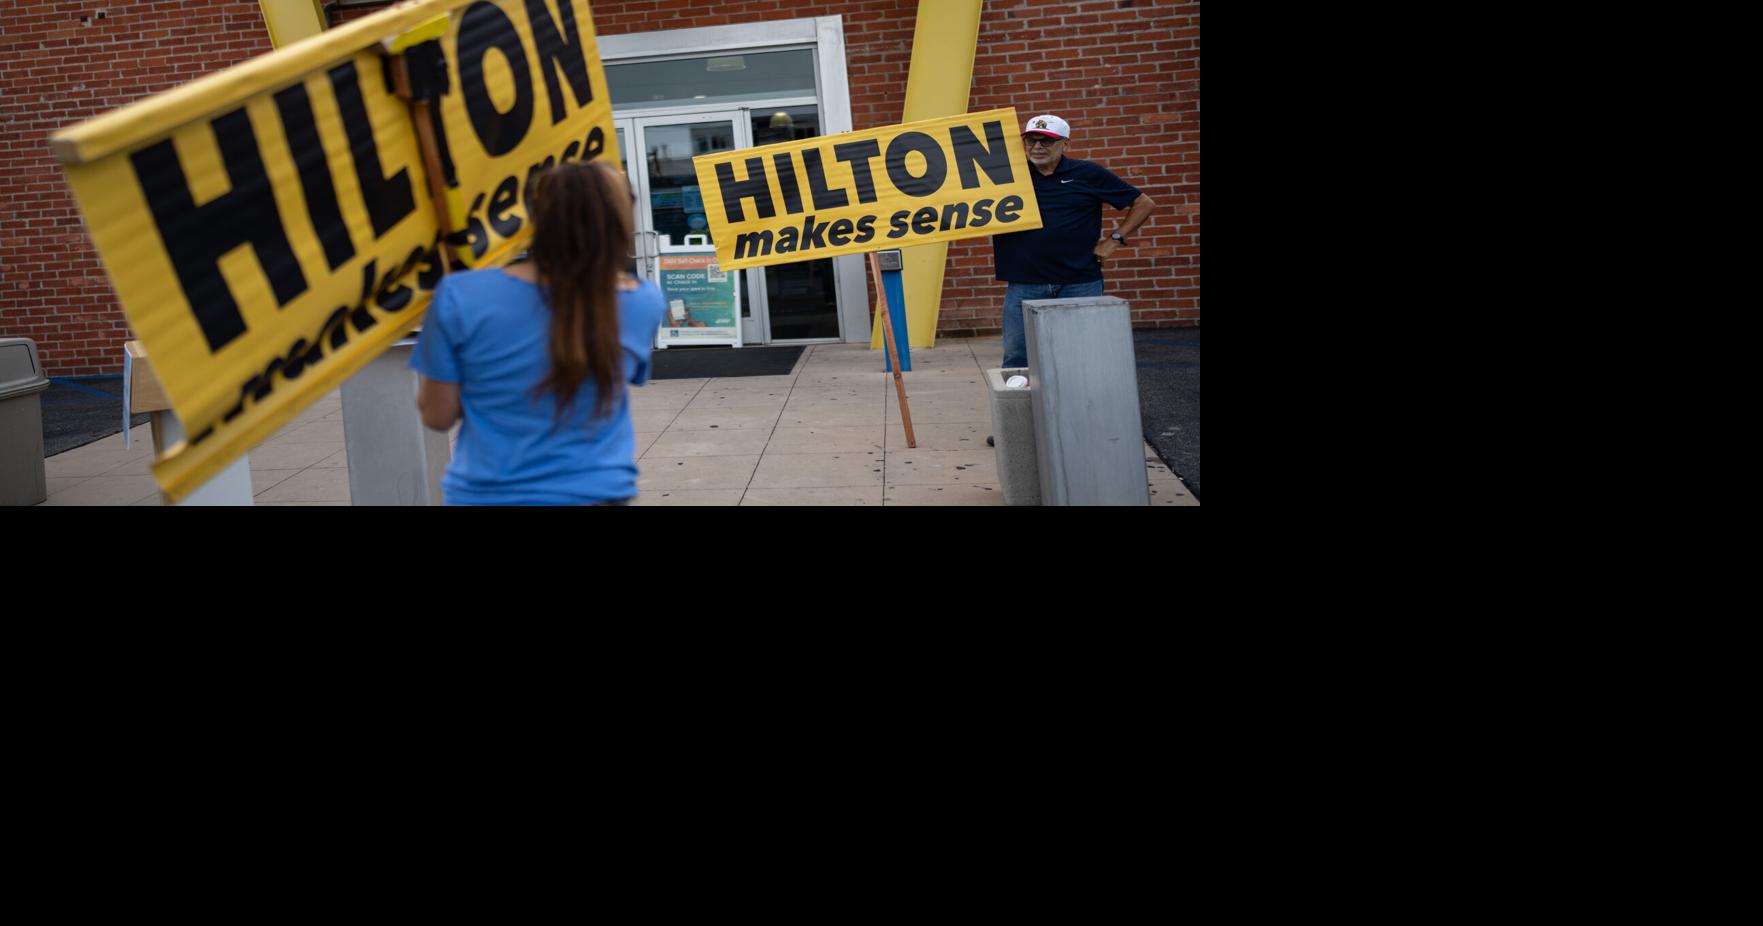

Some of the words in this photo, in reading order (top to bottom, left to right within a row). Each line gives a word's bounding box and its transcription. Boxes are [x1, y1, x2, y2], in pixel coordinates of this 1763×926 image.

[130, 0, 593, 354] HILTON
[715, 120, 1015, 224] HILTON
[734, 215, 877, 260] makes
[887, 195, 1024, 239] sense
